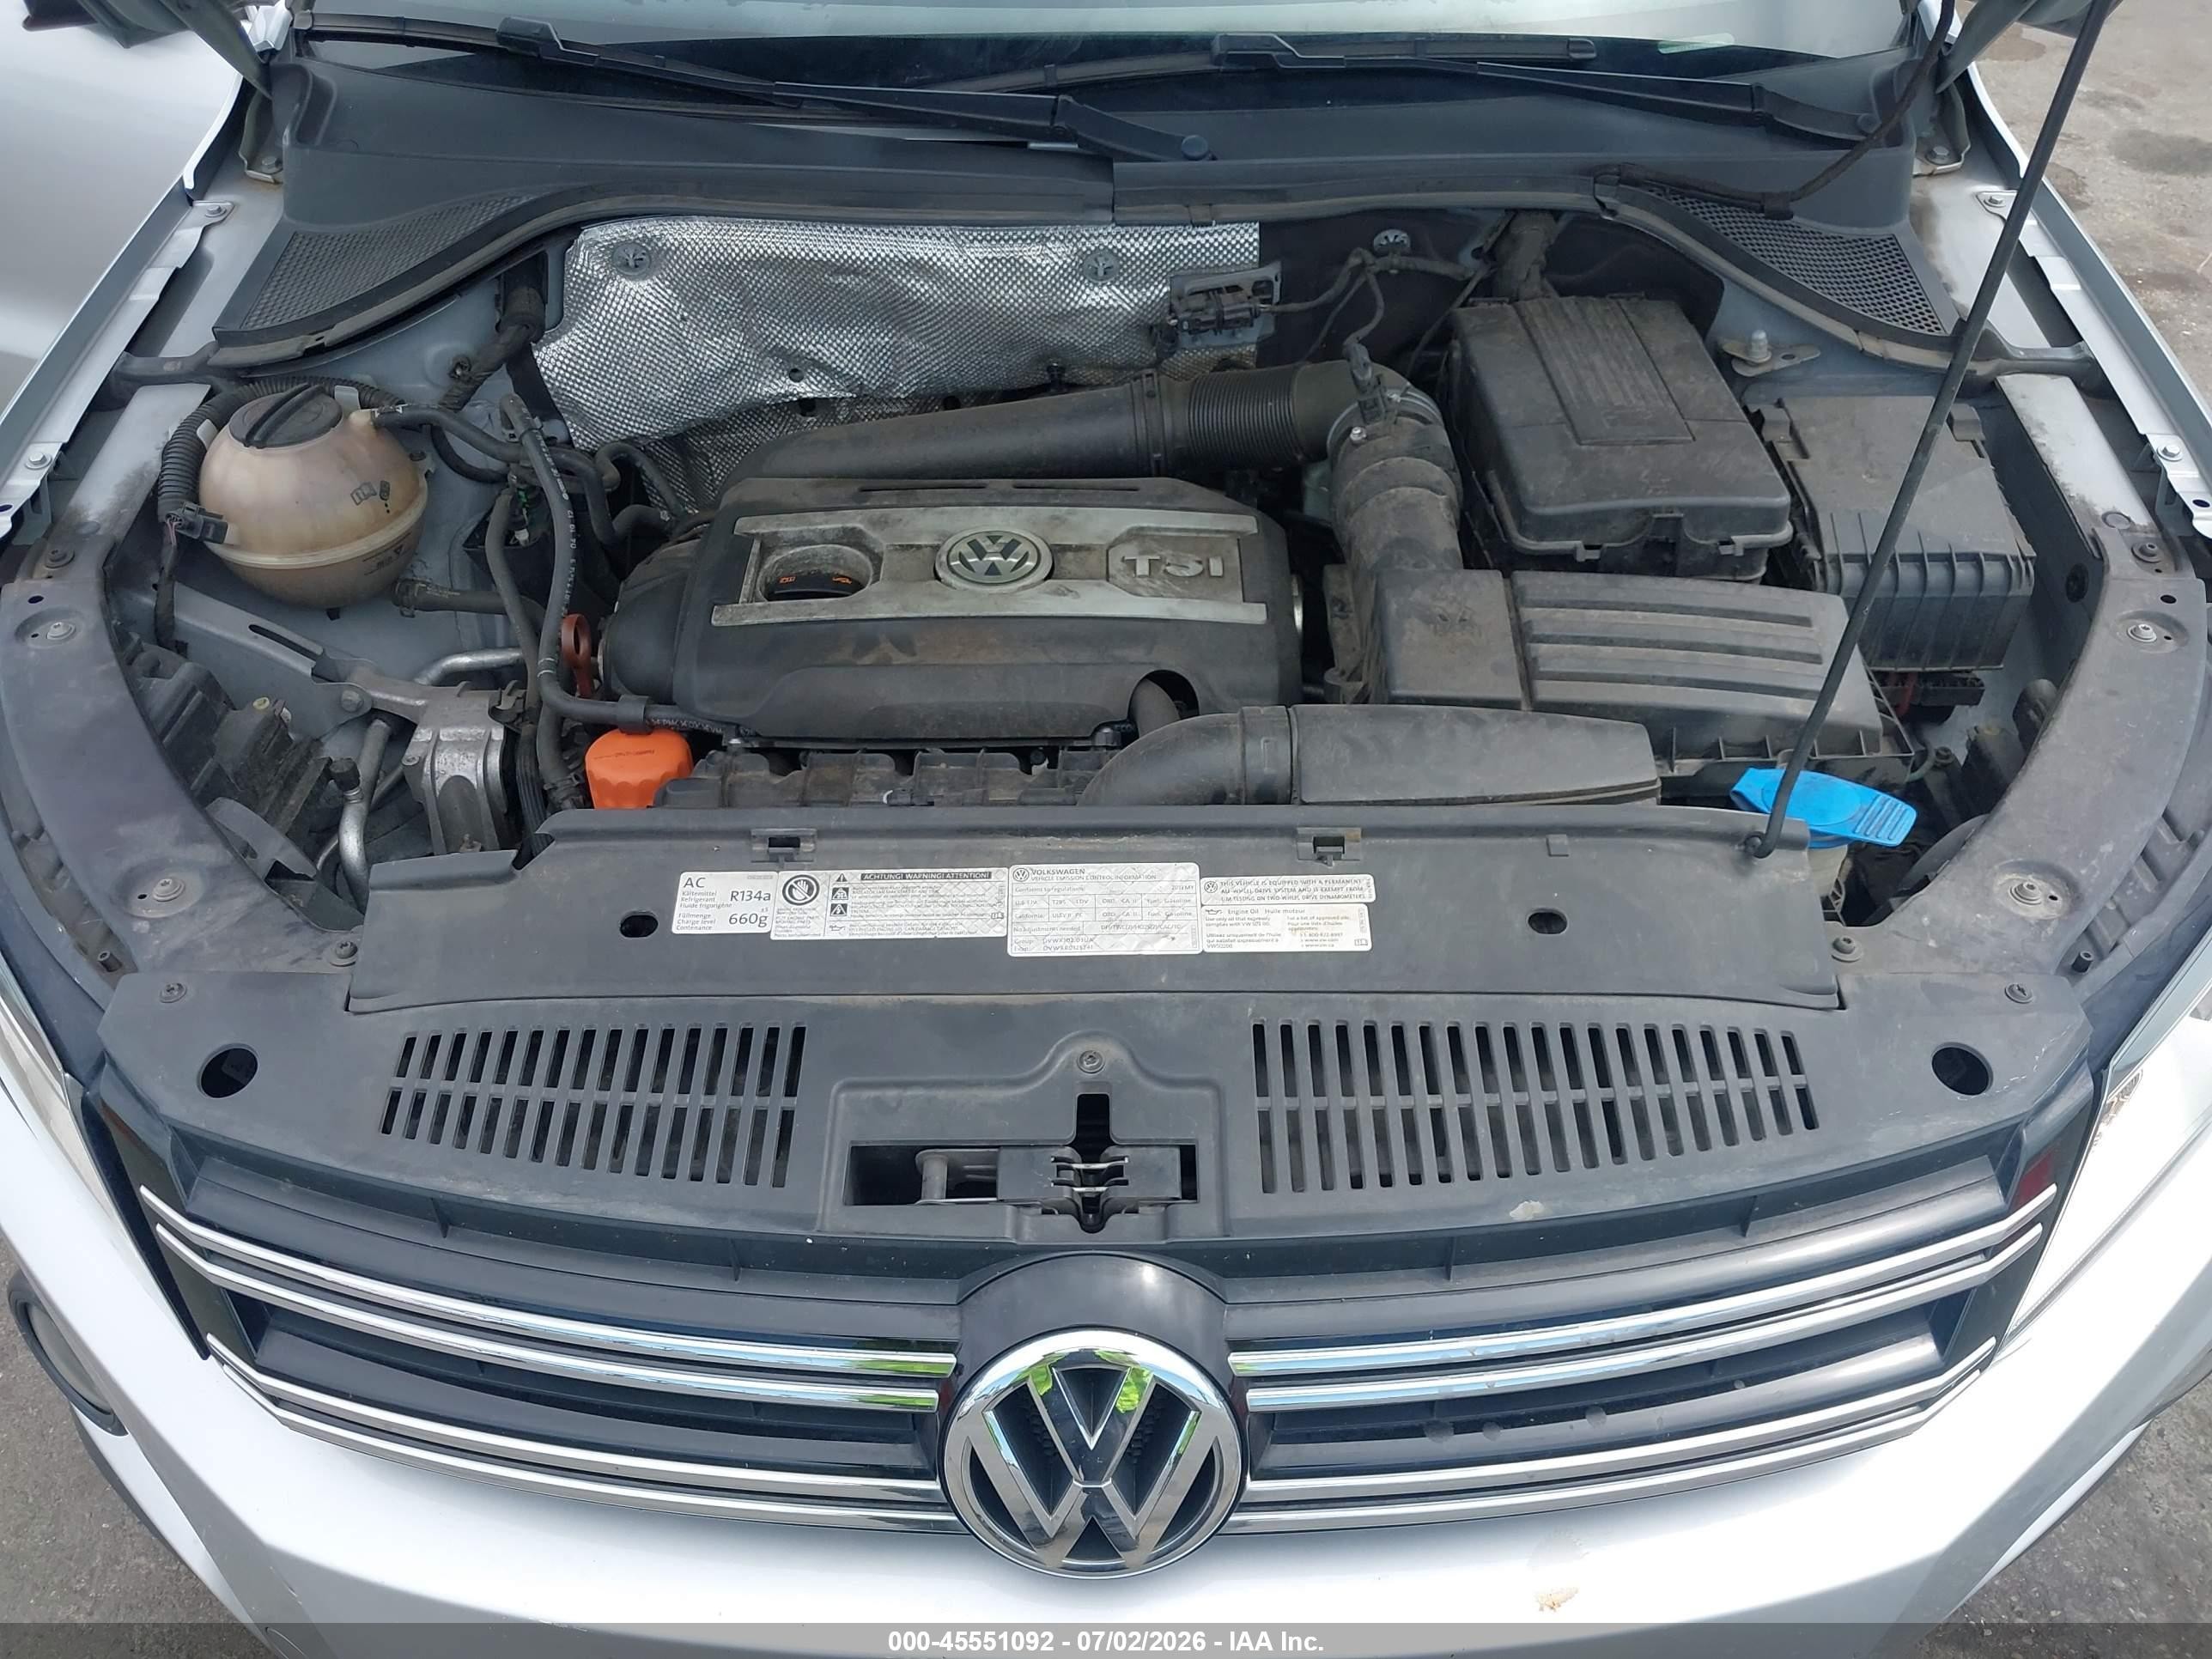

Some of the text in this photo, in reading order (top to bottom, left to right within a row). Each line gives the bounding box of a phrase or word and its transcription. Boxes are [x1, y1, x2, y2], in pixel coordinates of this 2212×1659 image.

[1121, 556, 1224, 578] TSI
[684, 876, 707, 888] AC
[729, 890, 771, 902] R134a
[728, 913, 769, 928] 660g
